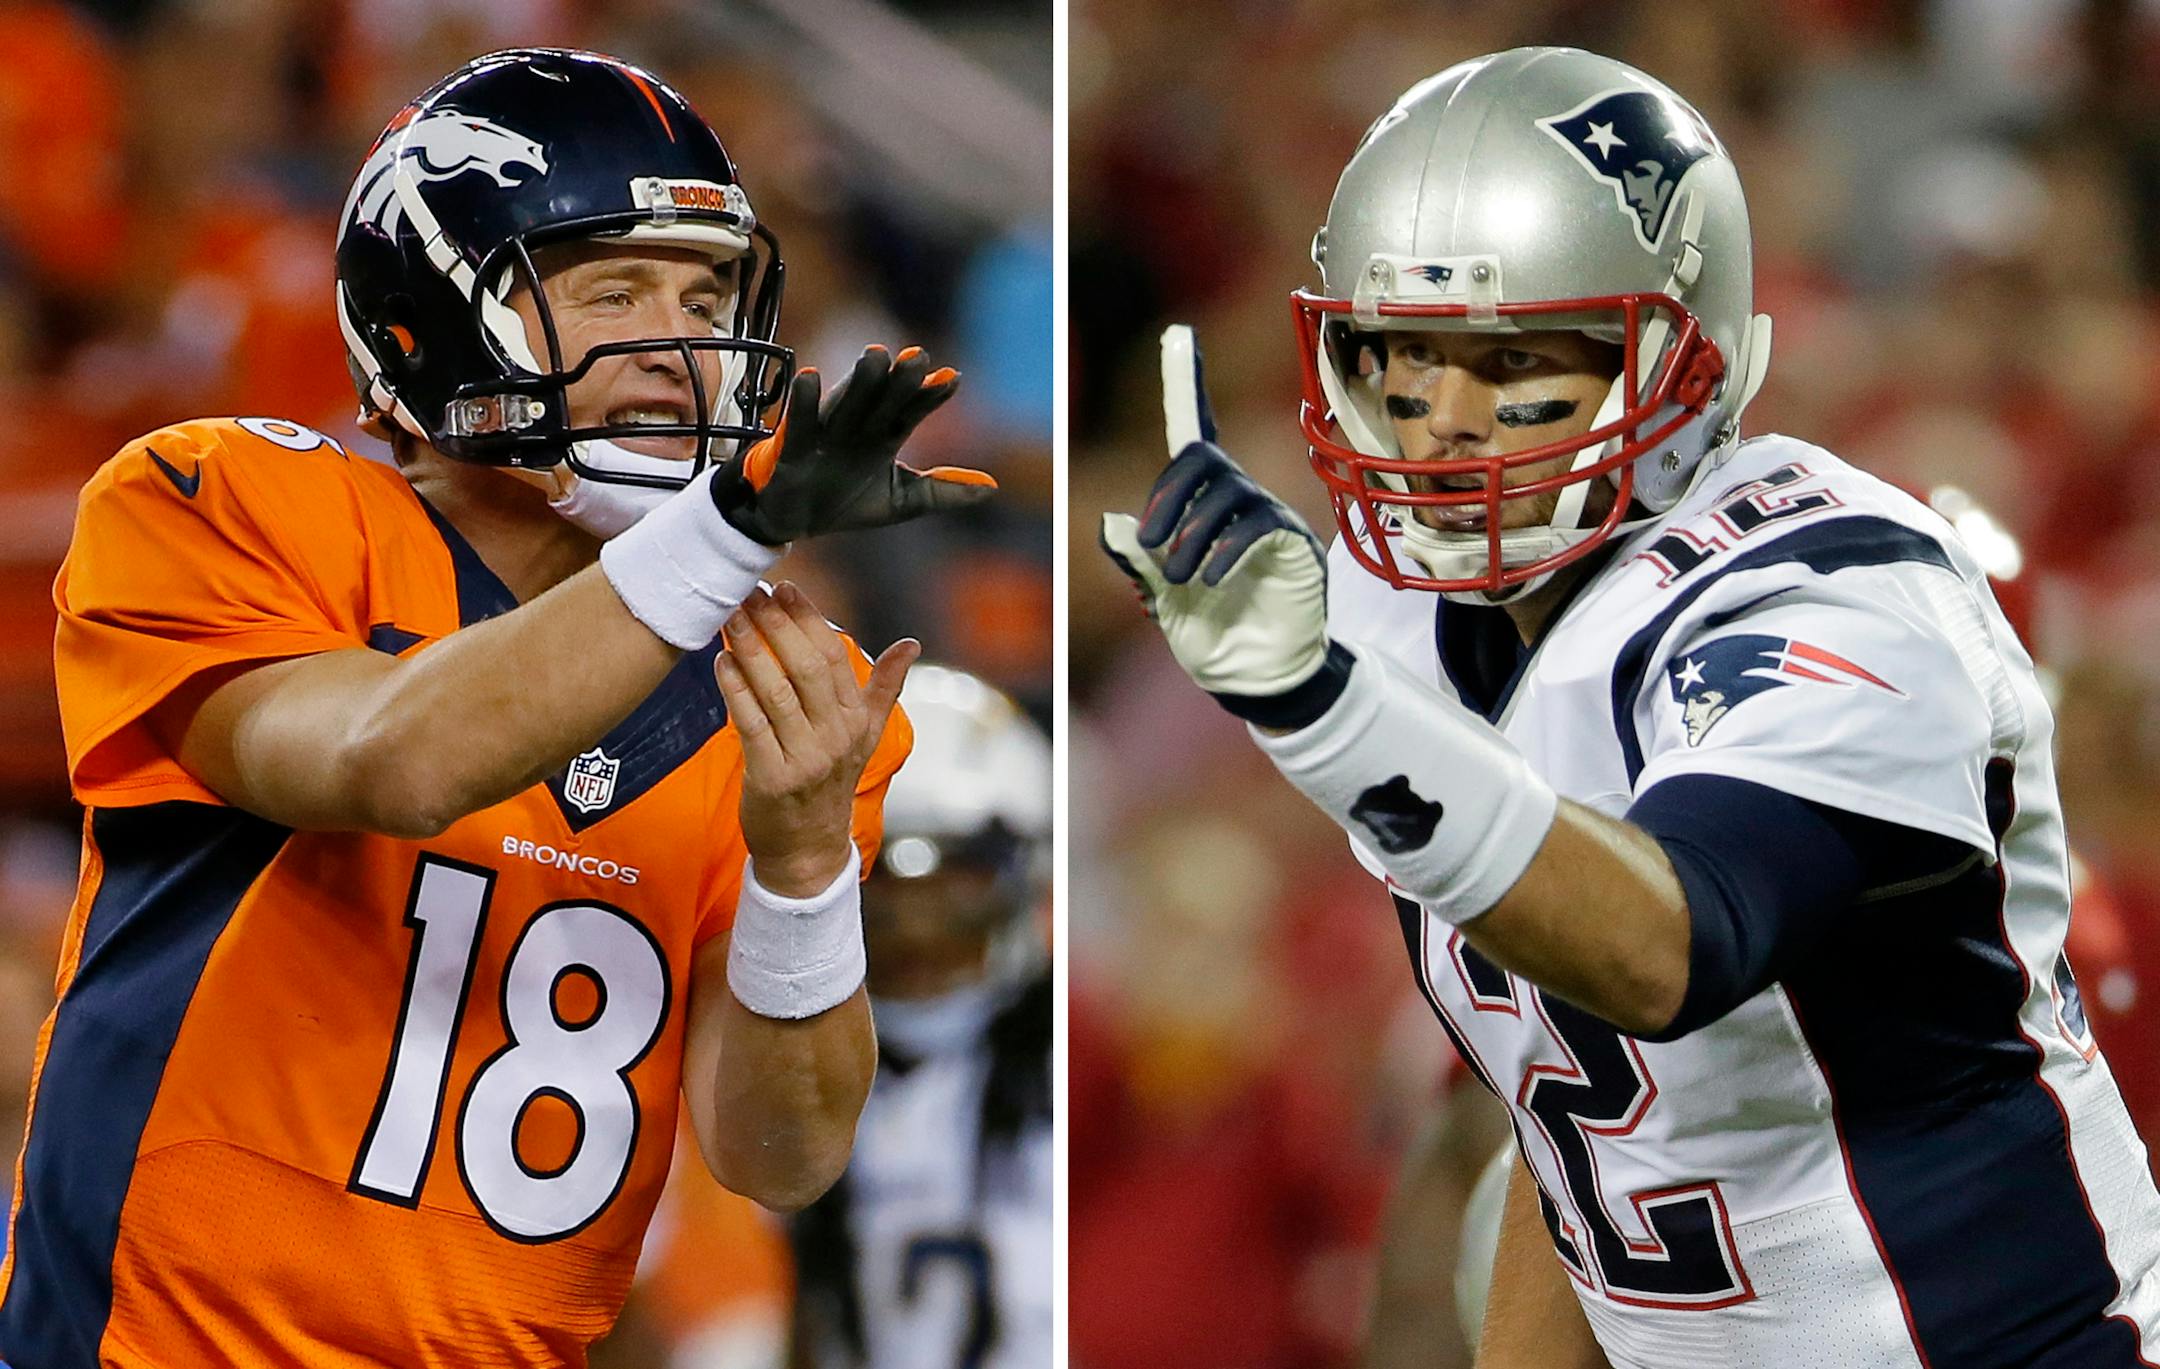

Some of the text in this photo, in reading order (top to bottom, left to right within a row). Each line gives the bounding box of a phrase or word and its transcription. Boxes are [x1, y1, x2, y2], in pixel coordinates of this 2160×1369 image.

[1621, 462, 1846, 589] 12
[573, 774, 606, 801] NFL
[501, 835, 641, 885] BRONCOS
[345, 850, 673, 1246] 18
